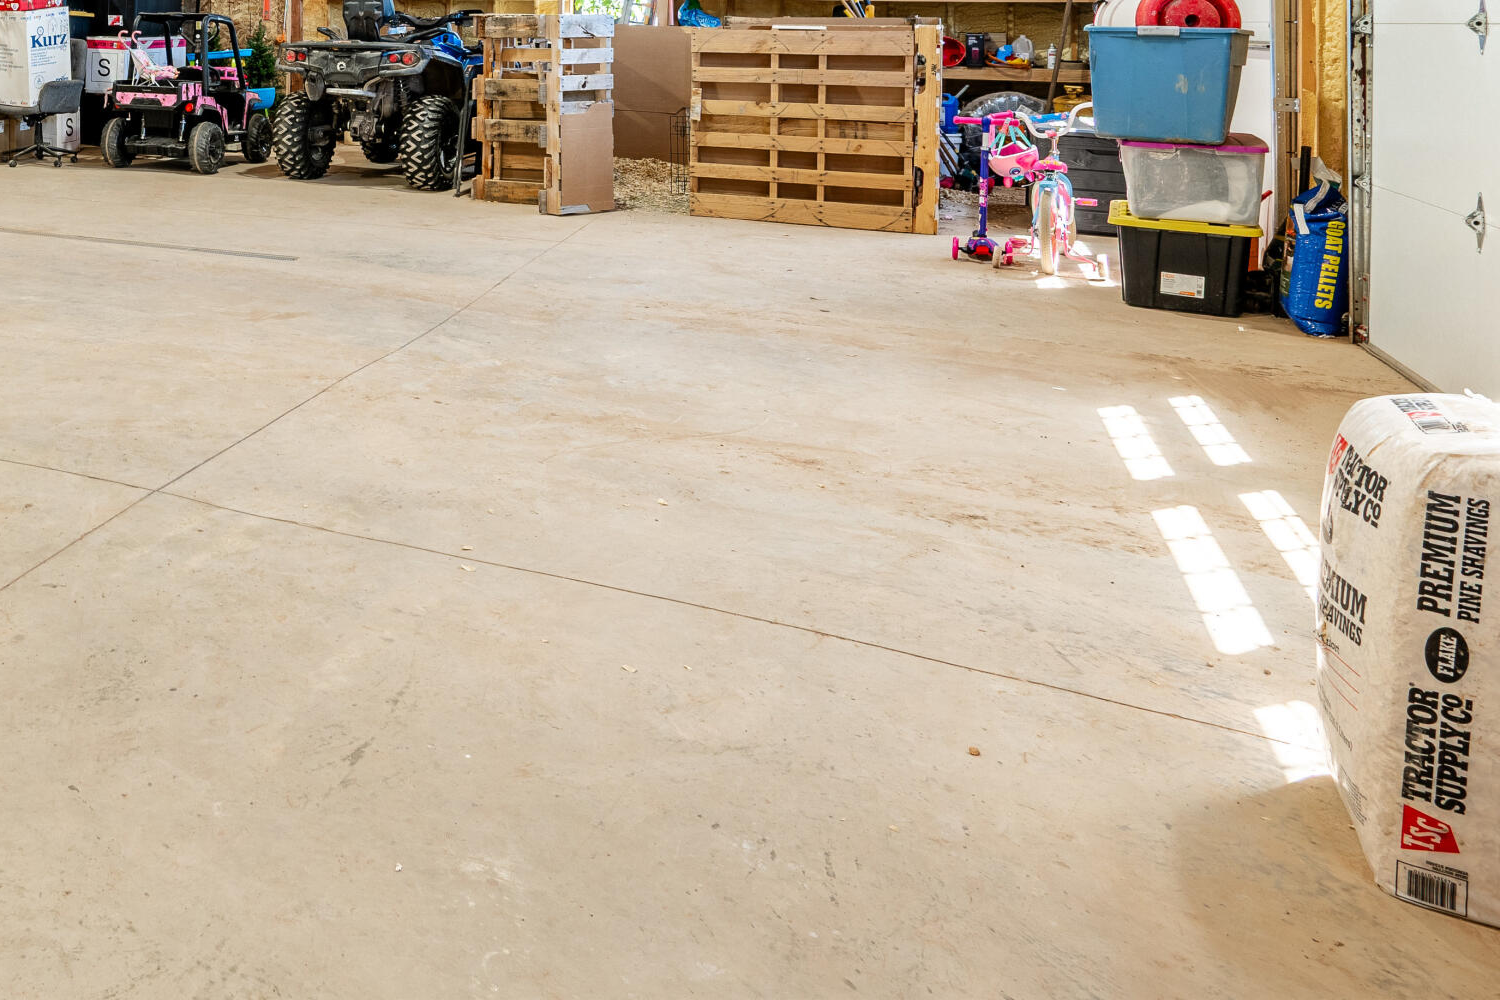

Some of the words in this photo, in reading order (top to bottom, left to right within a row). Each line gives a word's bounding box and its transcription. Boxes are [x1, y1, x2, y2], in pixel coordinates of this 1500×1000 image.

[30, 33, 67, 49] Kurz
[97, 58, 111, 77] S
[65, 117, 74, 137] S
[1324, 220, 1346, 254] GOAT
[1314, 254, 1341, 310] PELLETS
[1416, 490, 1462, 618] PREMIUM
[1460, 497, 1491, 580] SHAVINGS
[1456, 580, 1483, 624] PINE
[1437, 633, 1458, 677] FLAKE
[1401, 687, 1439, 803] TRACTOR
[1434, 721, 1472, 815] SUPPLY
[1403, 816, 1450, 851] TSC
